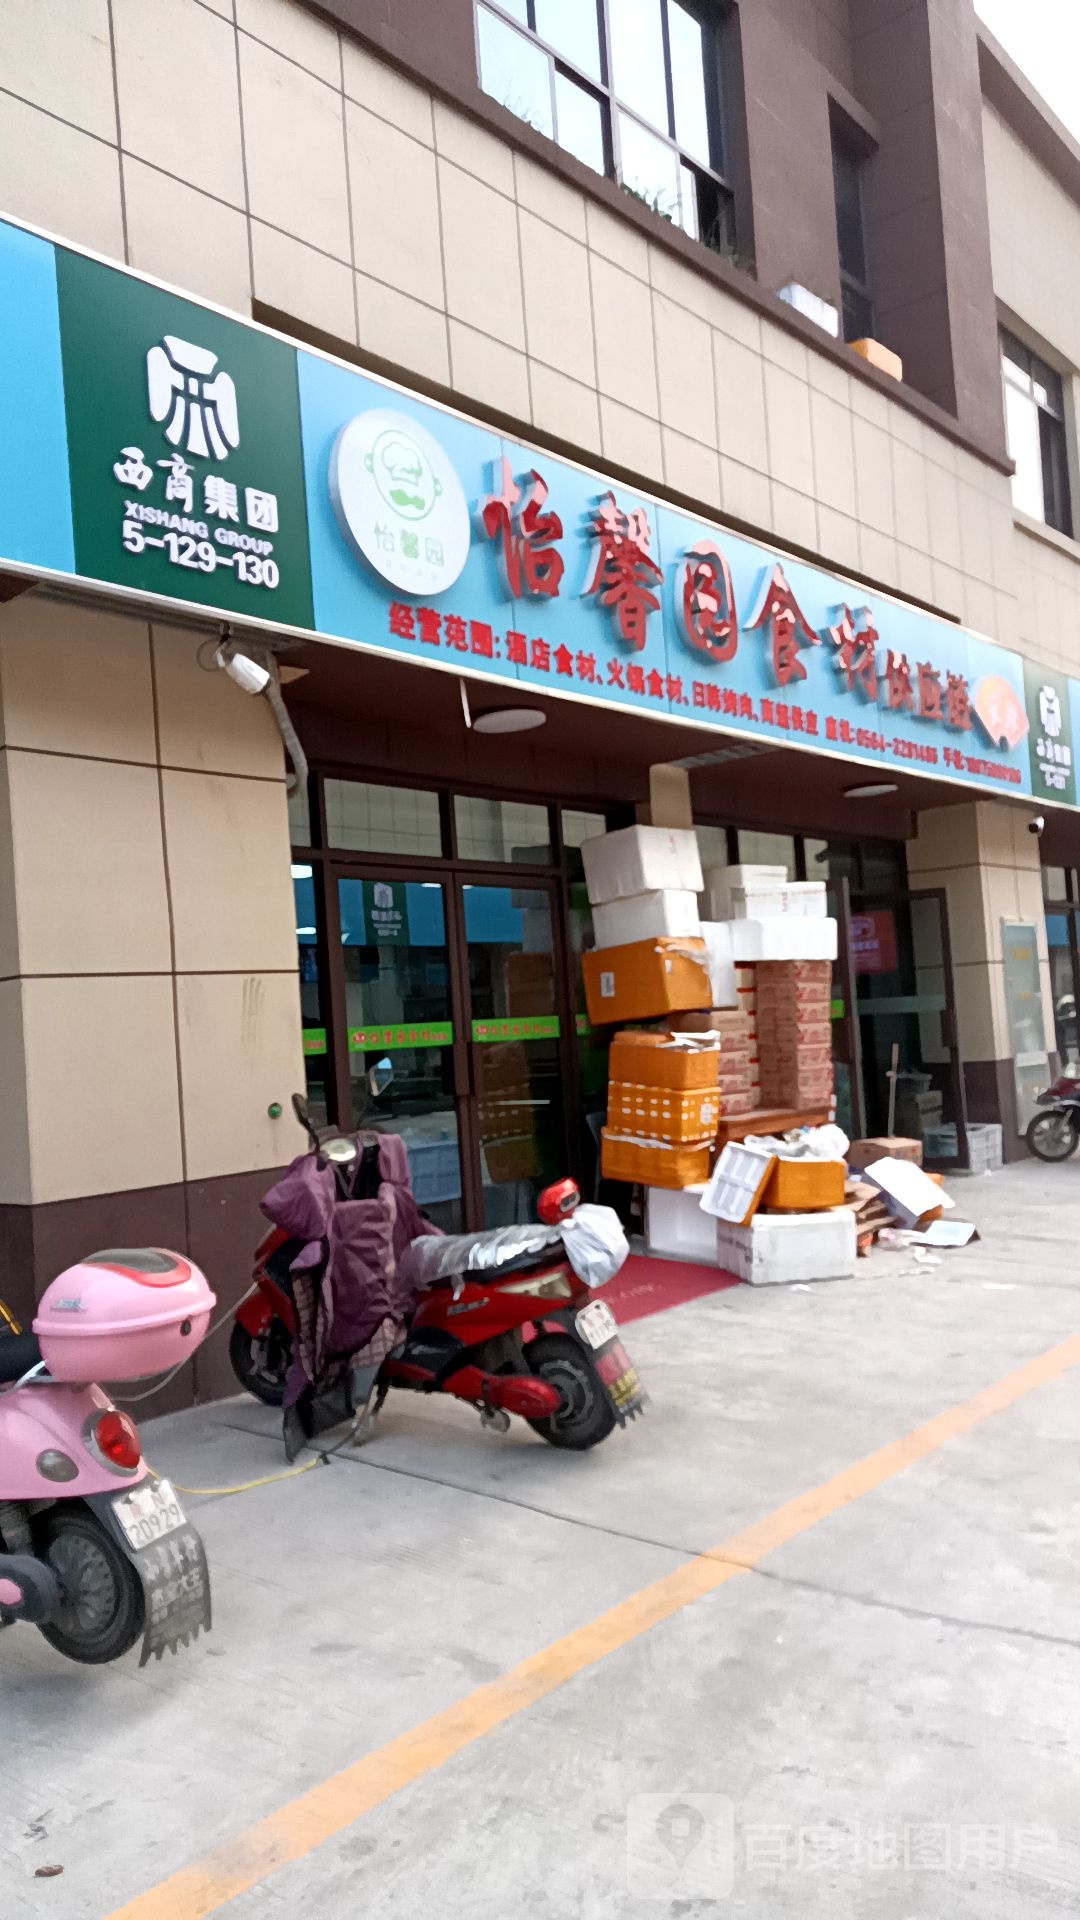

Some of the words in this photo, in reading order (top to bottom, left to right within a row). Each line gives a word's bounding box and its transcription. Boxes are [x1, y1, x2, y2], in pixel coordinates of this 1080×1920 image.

[113, 446, 278, 533] 西商集团
[122, 519, 279, 588] 5-129-130
[124, 500, 209, 539] XISHANG
[214, 527, 273, 556] GROUP
[129, 1503, 181, 1542] 20929
